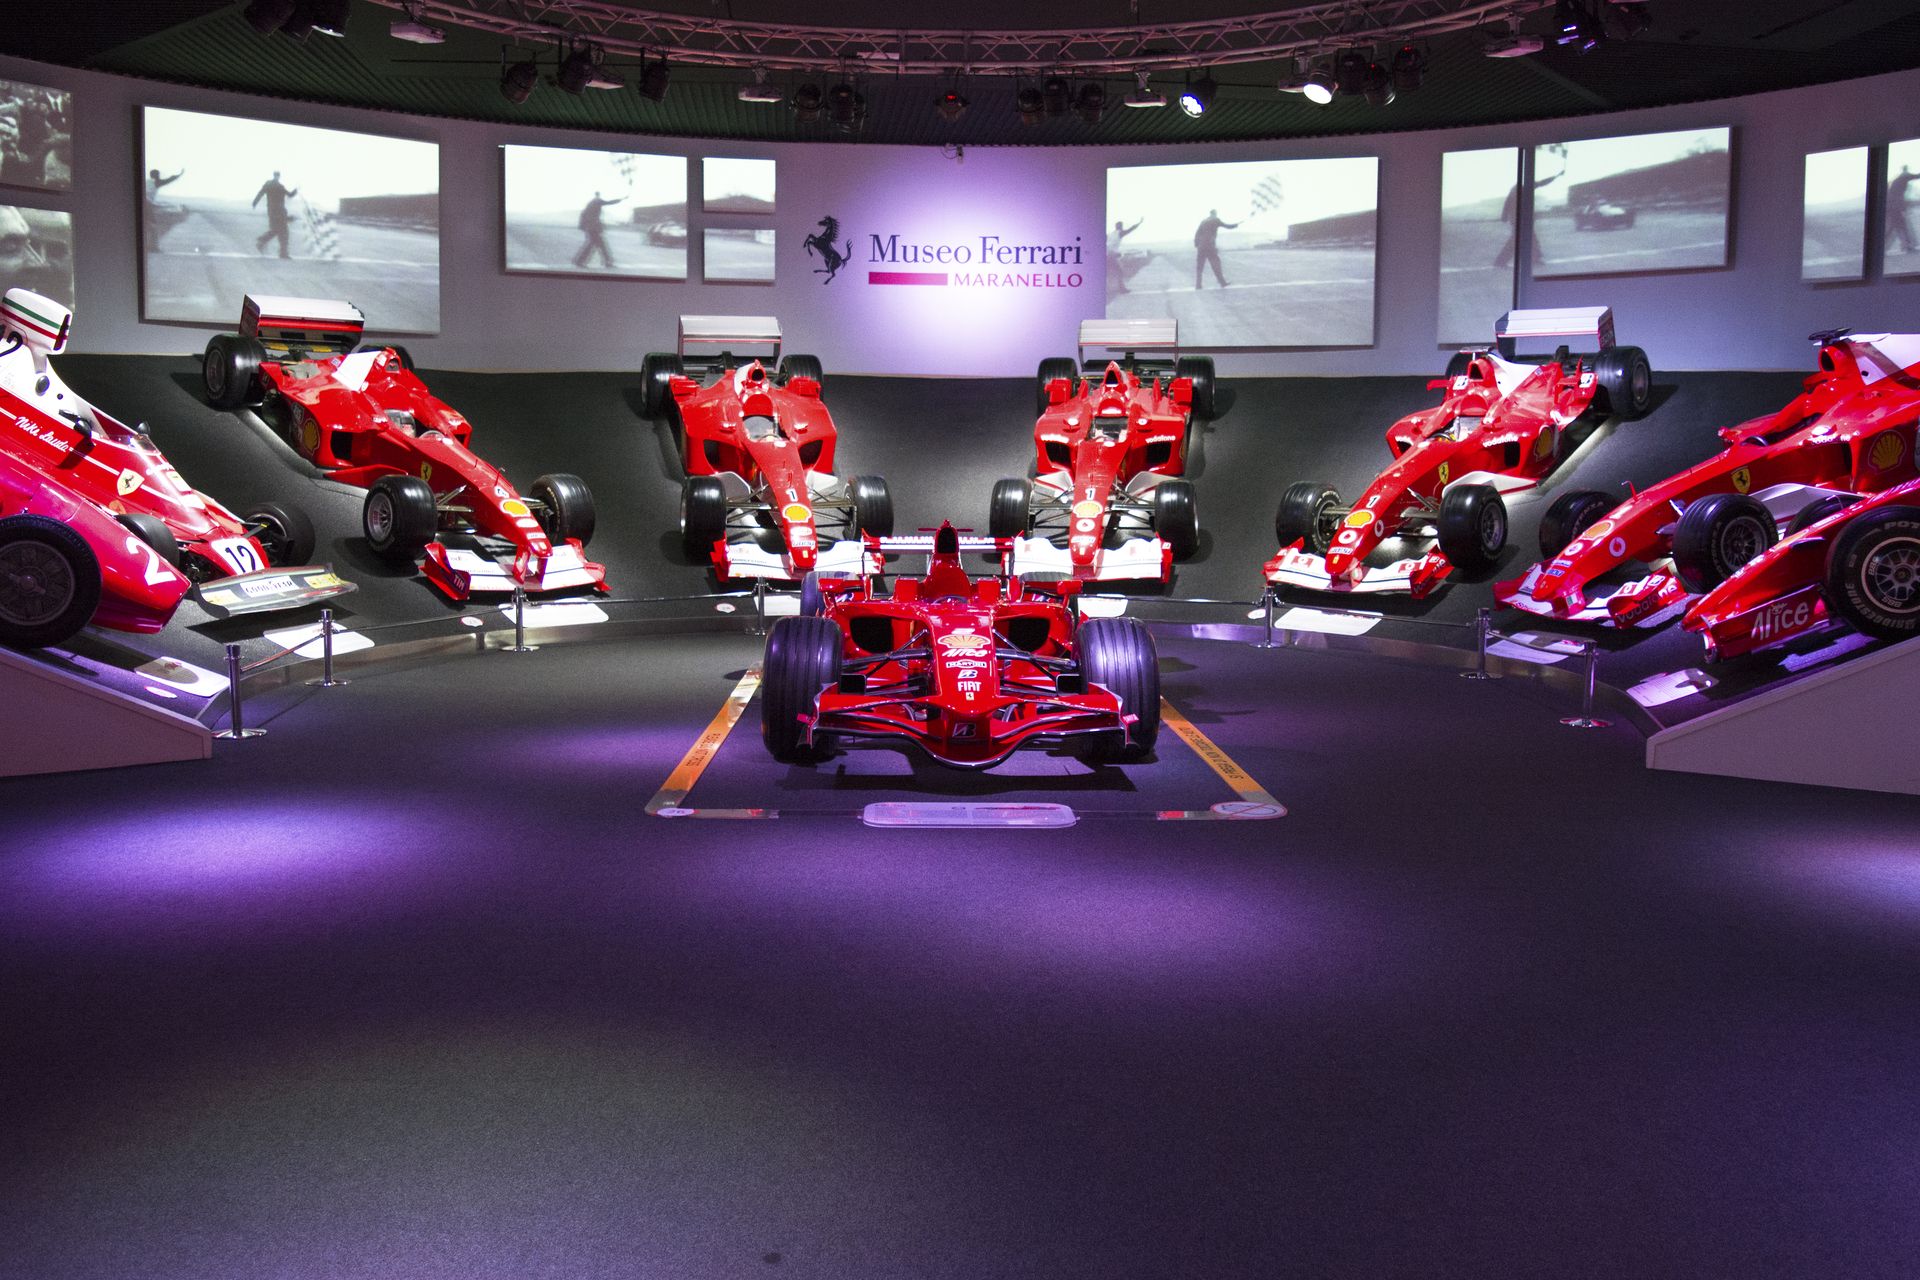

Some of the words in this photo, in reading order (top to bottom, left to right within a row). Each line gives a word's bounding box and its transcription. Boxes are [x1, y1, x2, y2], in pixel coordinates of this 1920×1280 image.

[868, 234, 972, 264] Museo
[978, 236, 1084, 265] Ferrari
[954, 273, 1083, 288] MARANELLO
[15, 416, 41, 437] Niki
[39, 431, 69, 453] Lauda
[125, 536, 177, 586] 2
[225, 544, 257, 574] 12
[1751, 602, 1809, 640] Alice
[957, 681, 982, 692] FIAT
